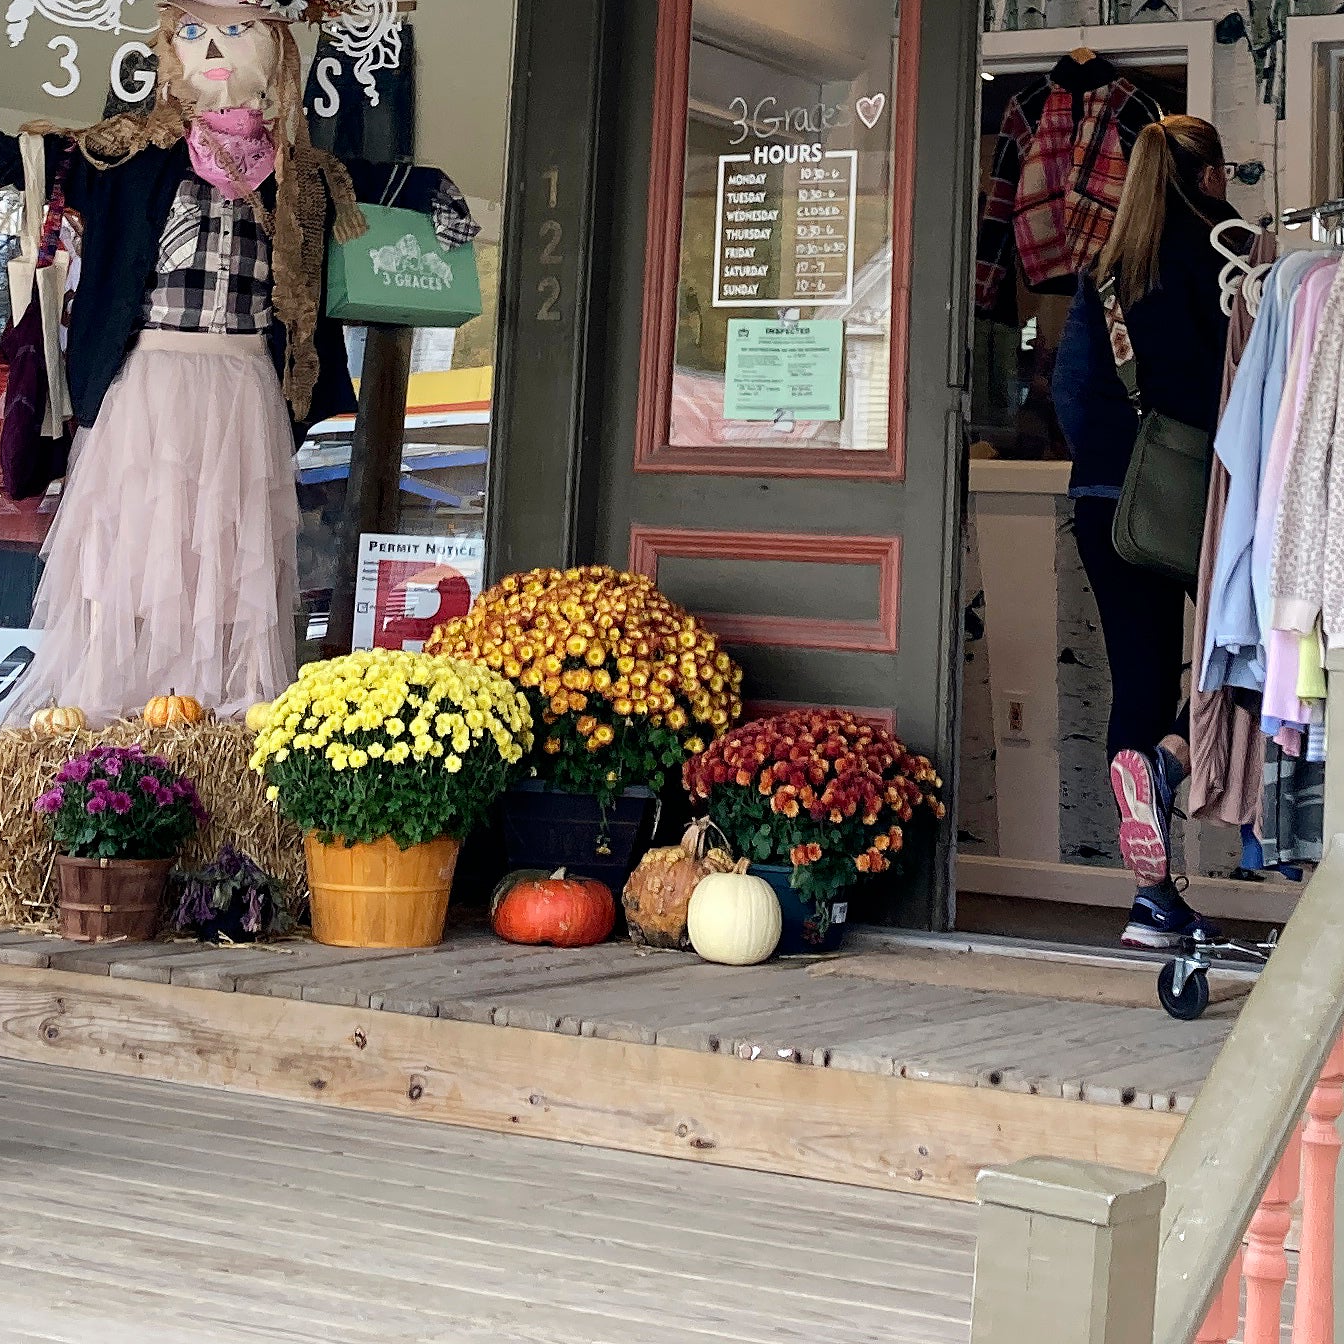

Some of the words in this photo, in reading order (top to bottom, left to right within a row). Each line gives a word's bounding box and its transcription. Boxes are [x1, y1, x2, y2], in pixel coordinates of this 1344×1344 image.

[753, 143, 823, 165] HOURS
[728, 173, 767, 185] MONDAY
[726, 191, 767, 204] TUESDAY
[726, 209, 779, 223] WEDNESDAY
[725, 228, 772, 241] THURSDAY
[724, 246, 756, 258] FRIDAY
[724, 265, 769, 277] SATURDAY
[382, 272, 391, 286] 3
[395, 273, 443, 291] GRACES
[722, 283, 759, 296] SUNDAY
[368, 540, 420, 554] PERMIT
[425, 543, 477, 557] NOTICE
